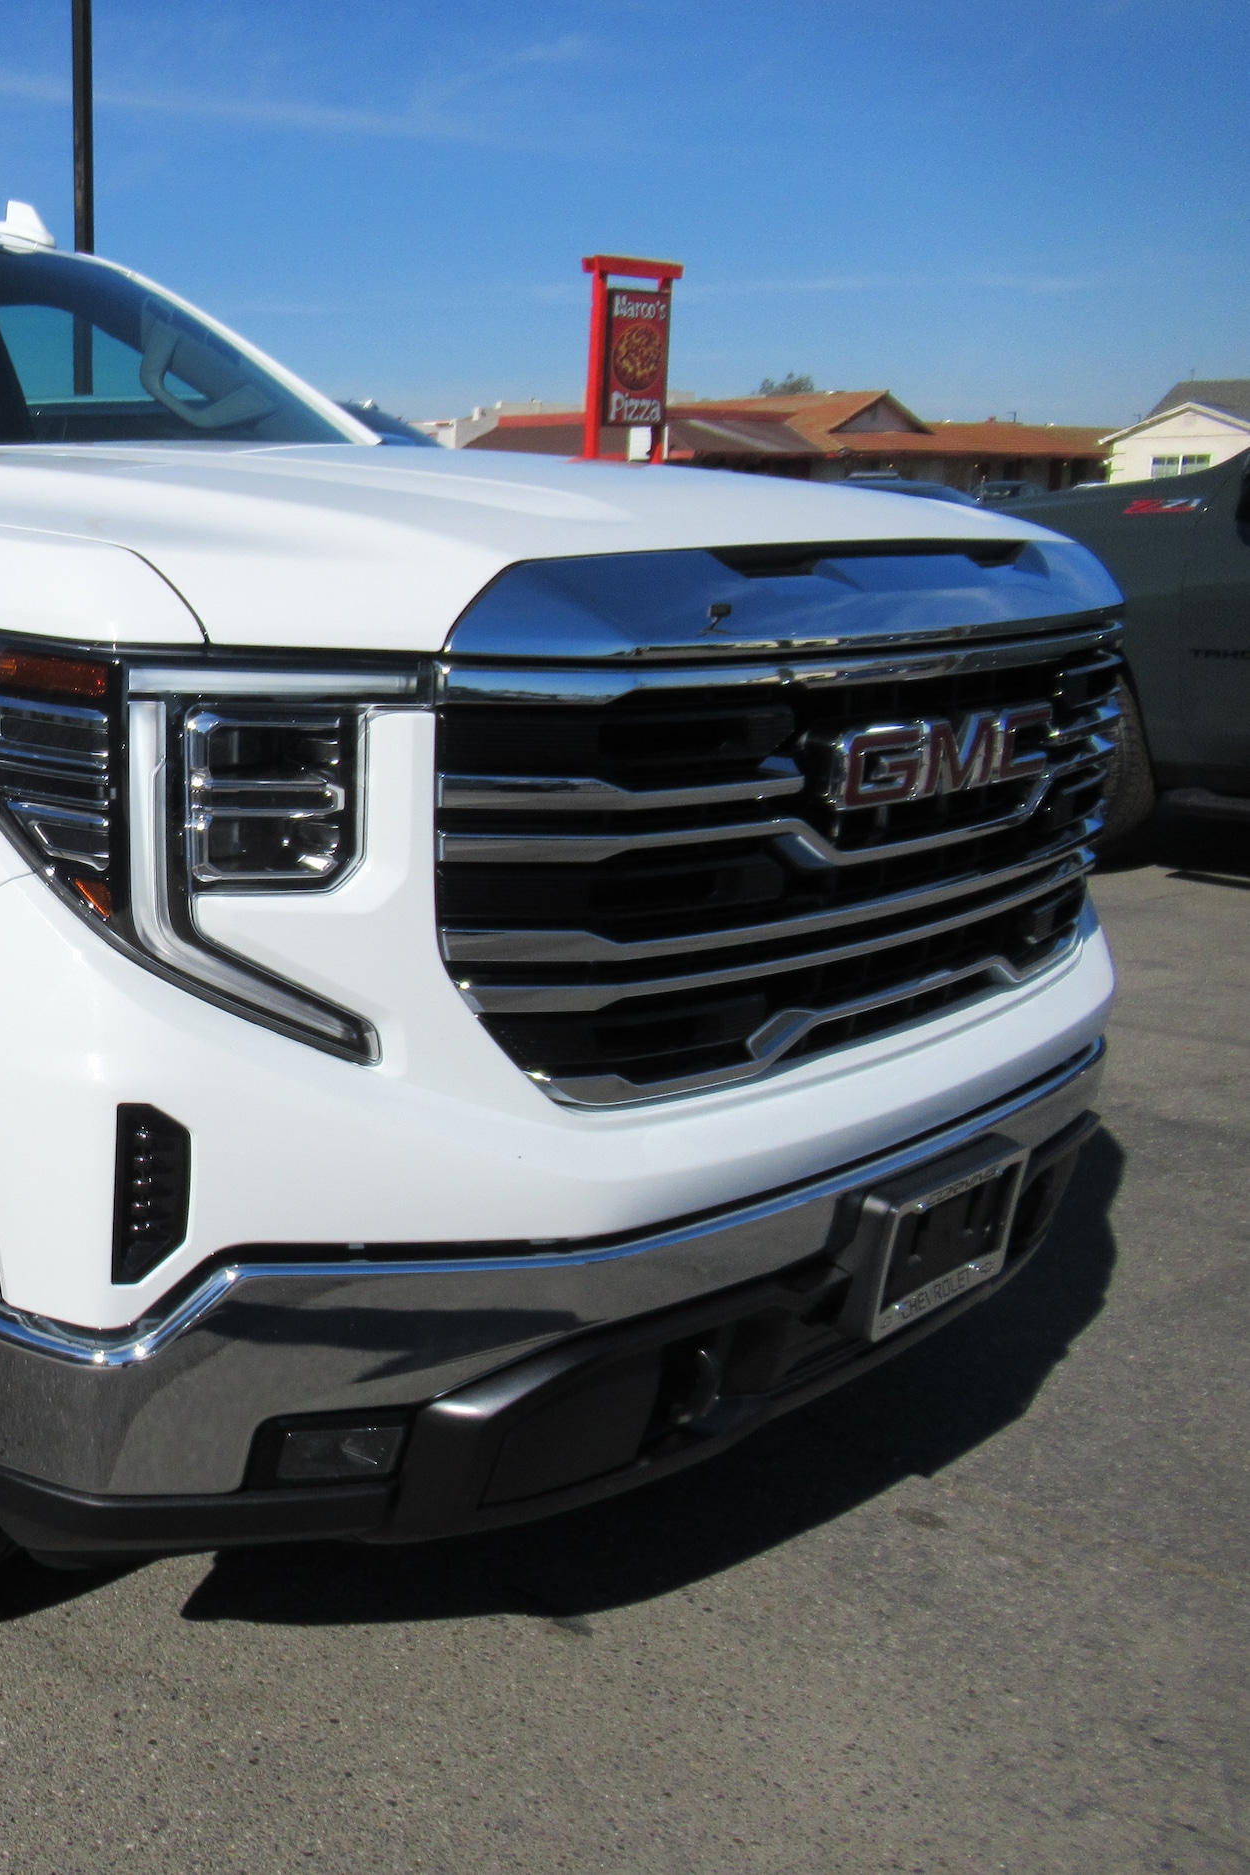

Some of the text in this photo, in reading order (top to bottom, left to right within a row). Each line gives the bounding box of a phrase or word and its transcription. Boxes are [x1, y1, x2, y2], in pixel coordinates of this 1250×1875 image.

[613, 294, 668, 320] Marco's
[610, 390, 661, 422] Pizza
[1123, 497, 1204, 515] Z71
[832, 701, 1053, 812] GMC
